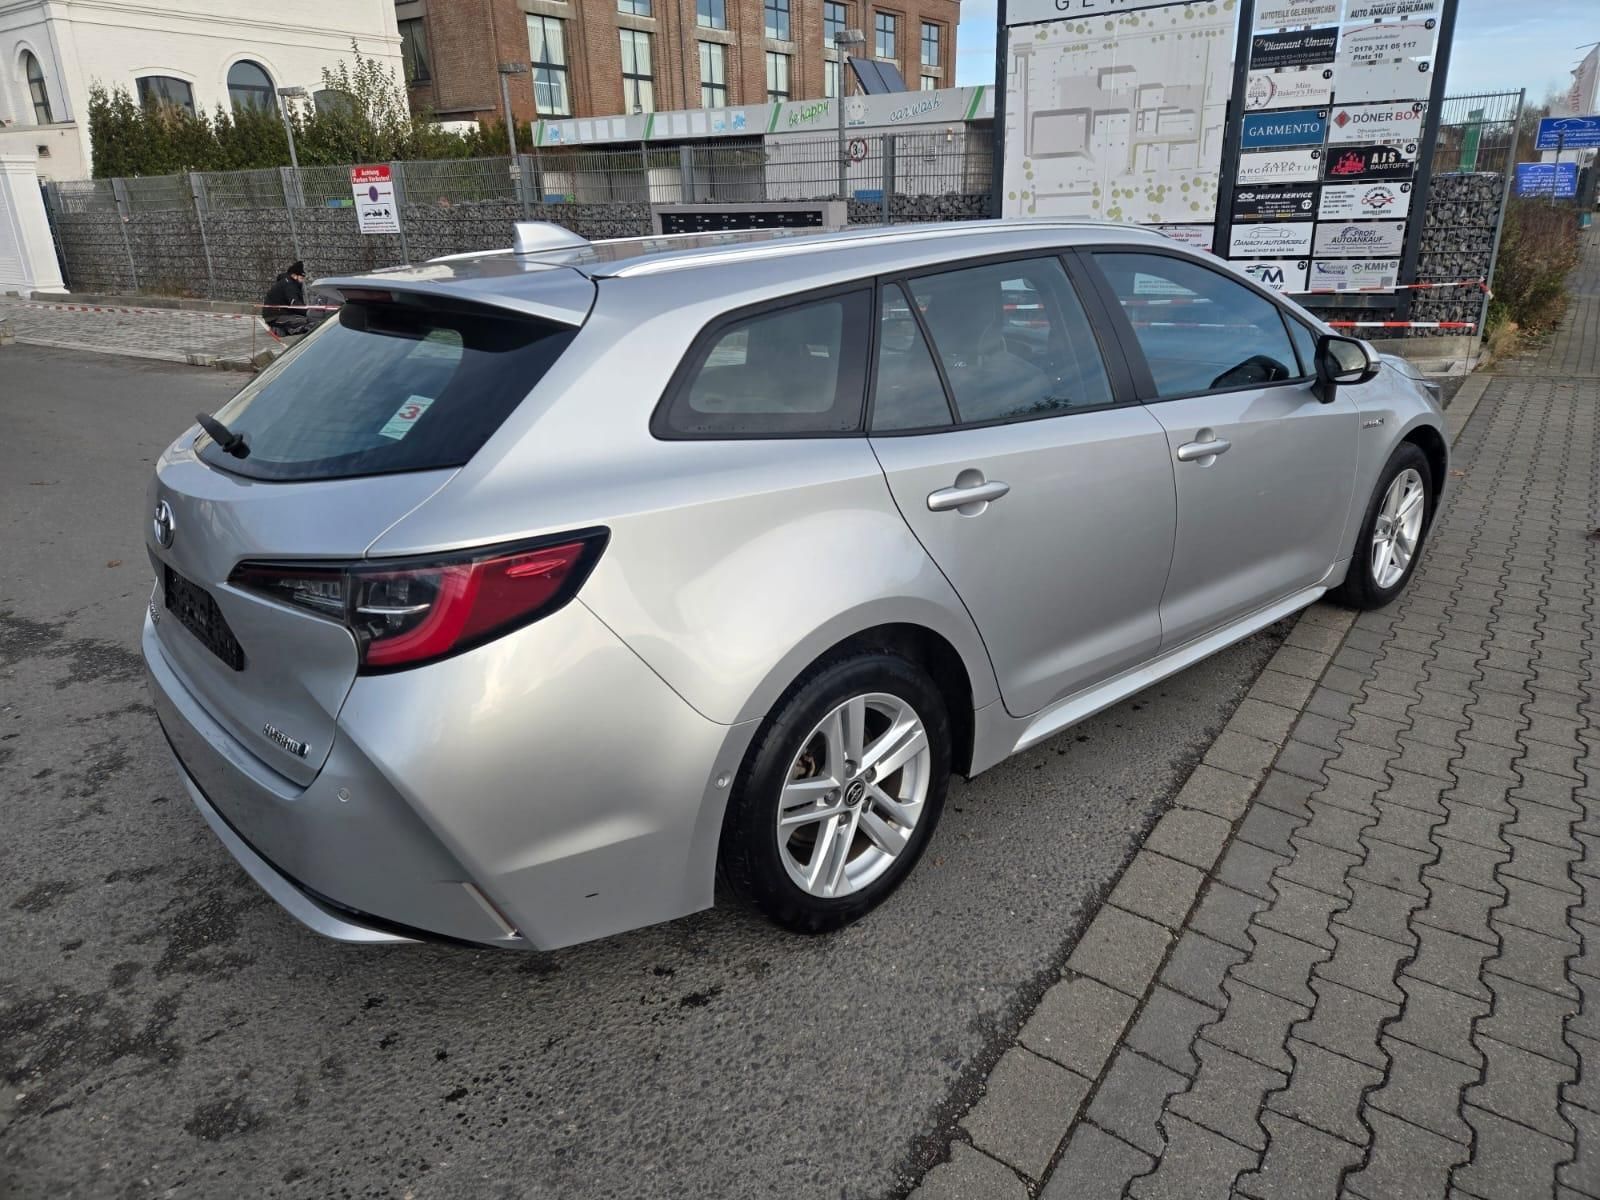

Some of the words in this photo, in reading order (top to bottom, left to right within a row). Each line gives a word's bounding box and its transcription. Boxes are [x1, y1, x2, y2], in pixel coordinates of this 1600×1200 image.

[1261, 10, 1289, 20] AUTOTEILE
[1351, 9, 1368, 18] AUTO
[1368, 6, 1395, 16] ANKAUF
[1397, 3, 1434, 14] DAHLMANN
[1375, 43, 1388, 51] 321
[889, 107, 909, 122] car
[911, 93, 942, 116] wash
[788, 110, 800, 127] be
[800, 100, 830, 125] happy
[1353, 111, 1393, 124] DÖNER
[1395, 110, 1420, 121] BOX
[1249, 122, 1320, 137] GARMENTO
[1240, 164, 1318, 175] ARCHITEKTUR
[1369, 162, 1410, 170] BAUSTOFFE
[1255, 192, 1281, 200] REIFEN
[1282, 191, 1313, 199] SERVICE
[1331, 236, 1385, 244] AUTOANKAUF
[1364, 262, 1390, 271] KMH
